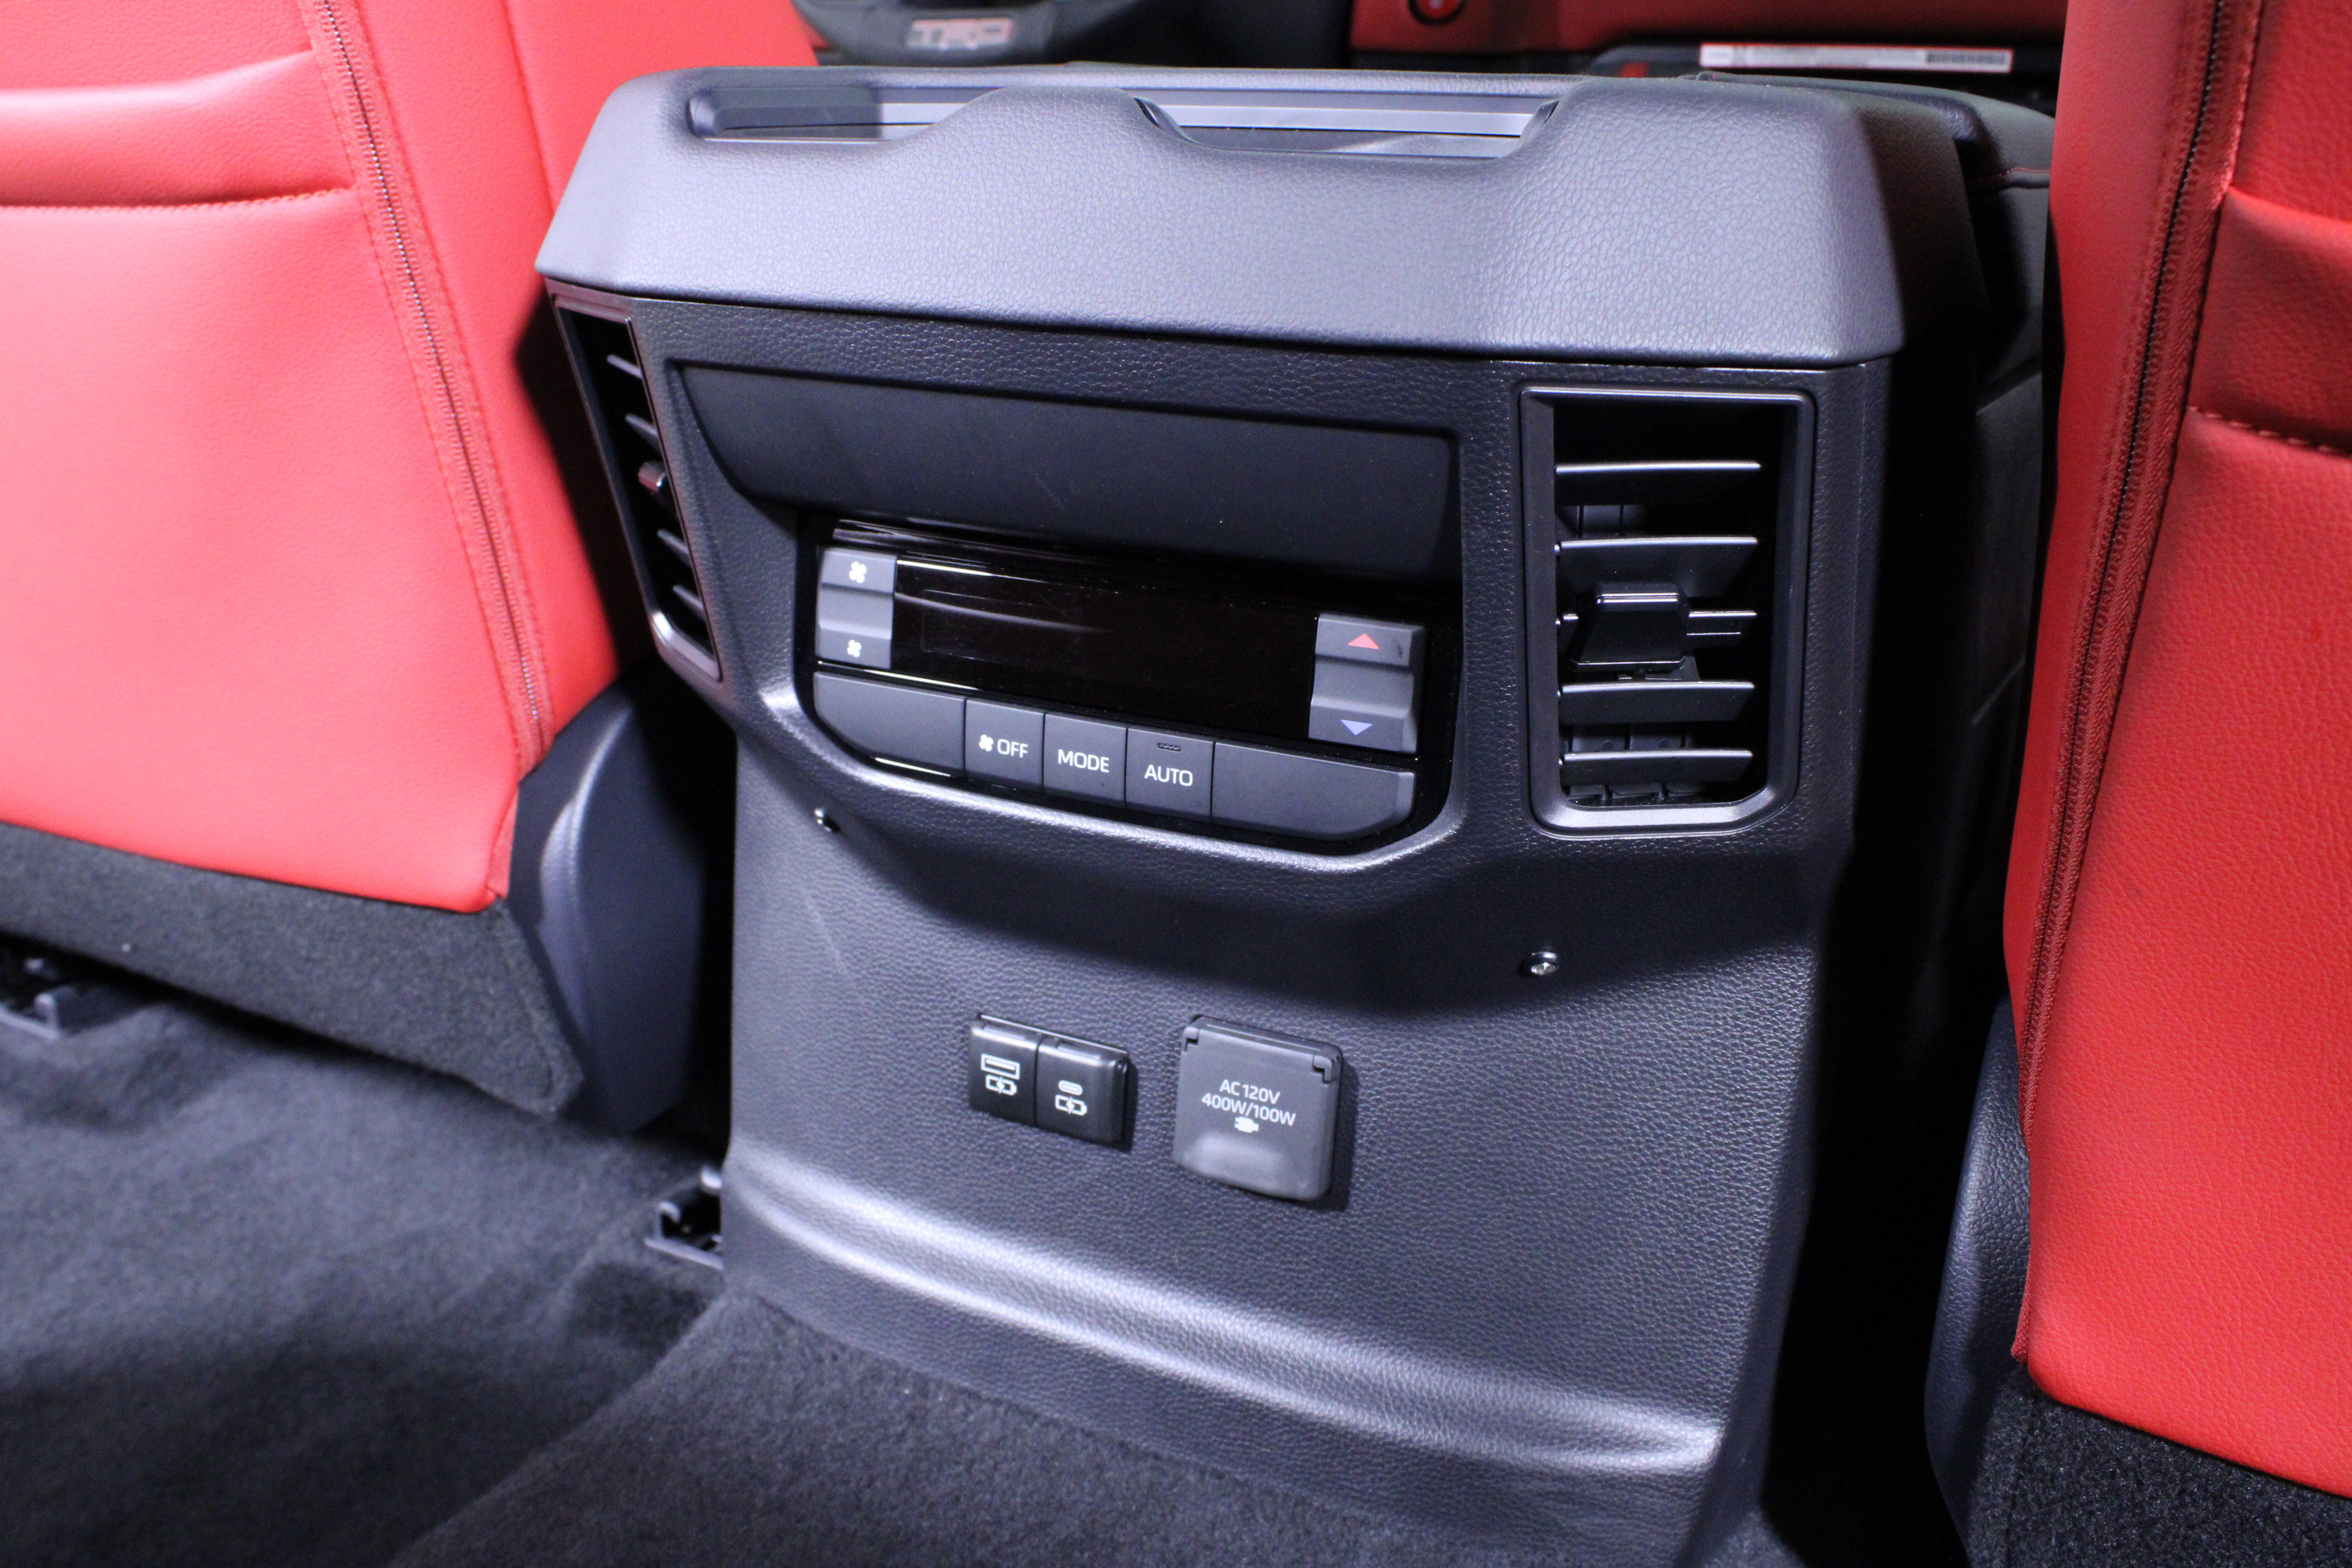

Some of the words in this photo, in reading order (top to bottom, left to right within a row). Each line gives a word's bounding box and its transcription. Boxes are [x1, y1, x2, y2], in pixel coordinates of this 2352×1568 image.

[997, 738, 1028, 759] OFF
[1057, 749, 1110, 773] MODE
[1144, 764, 1193, 787] AUTO
[1201, 1093, 1296, 1126] 400W/100W
